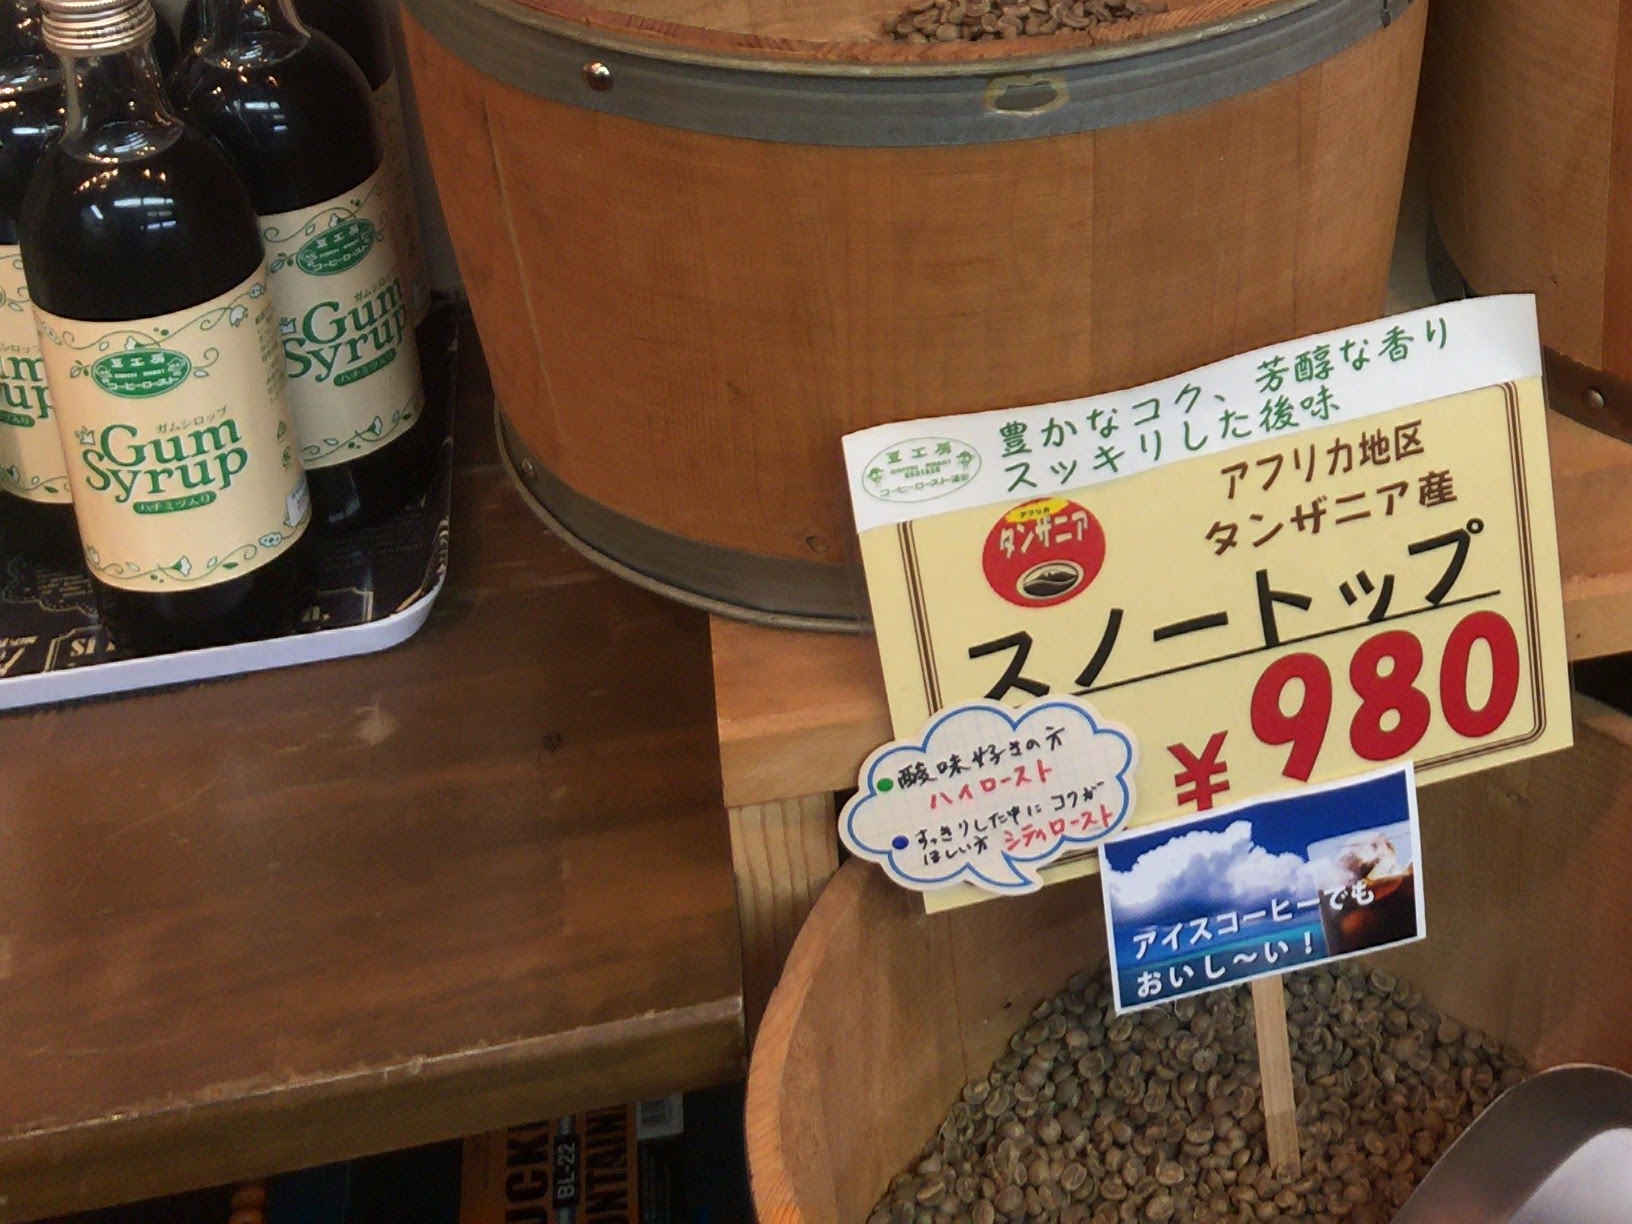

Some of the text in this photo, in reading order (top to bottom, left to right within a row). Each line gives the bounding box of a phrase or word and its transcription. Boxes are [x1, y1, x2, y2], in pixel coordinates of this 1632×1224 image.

[100, 417, 242, 467] Gum
[156, 405, 228, 434] ガムシロップ
[886, 441, 952, 465] 豆工房
[1004, 391, 1342, 494] スッキリした後味
[82, 447, 248, 504] Syrup
[1220, 419, 1425, 502] アフリカ地区
[1000, 510, 1088, 559] タンザニア
[1205, 470, 1458, 558] タンザニア産
[968, 518, 1484, 700] スノートップ
[1166, 609, 1520, 811] ¥980
[929, 759, 1053, 810] ハイロースト
[1133, 881, 1375, 960] アイスコーヒーでも
